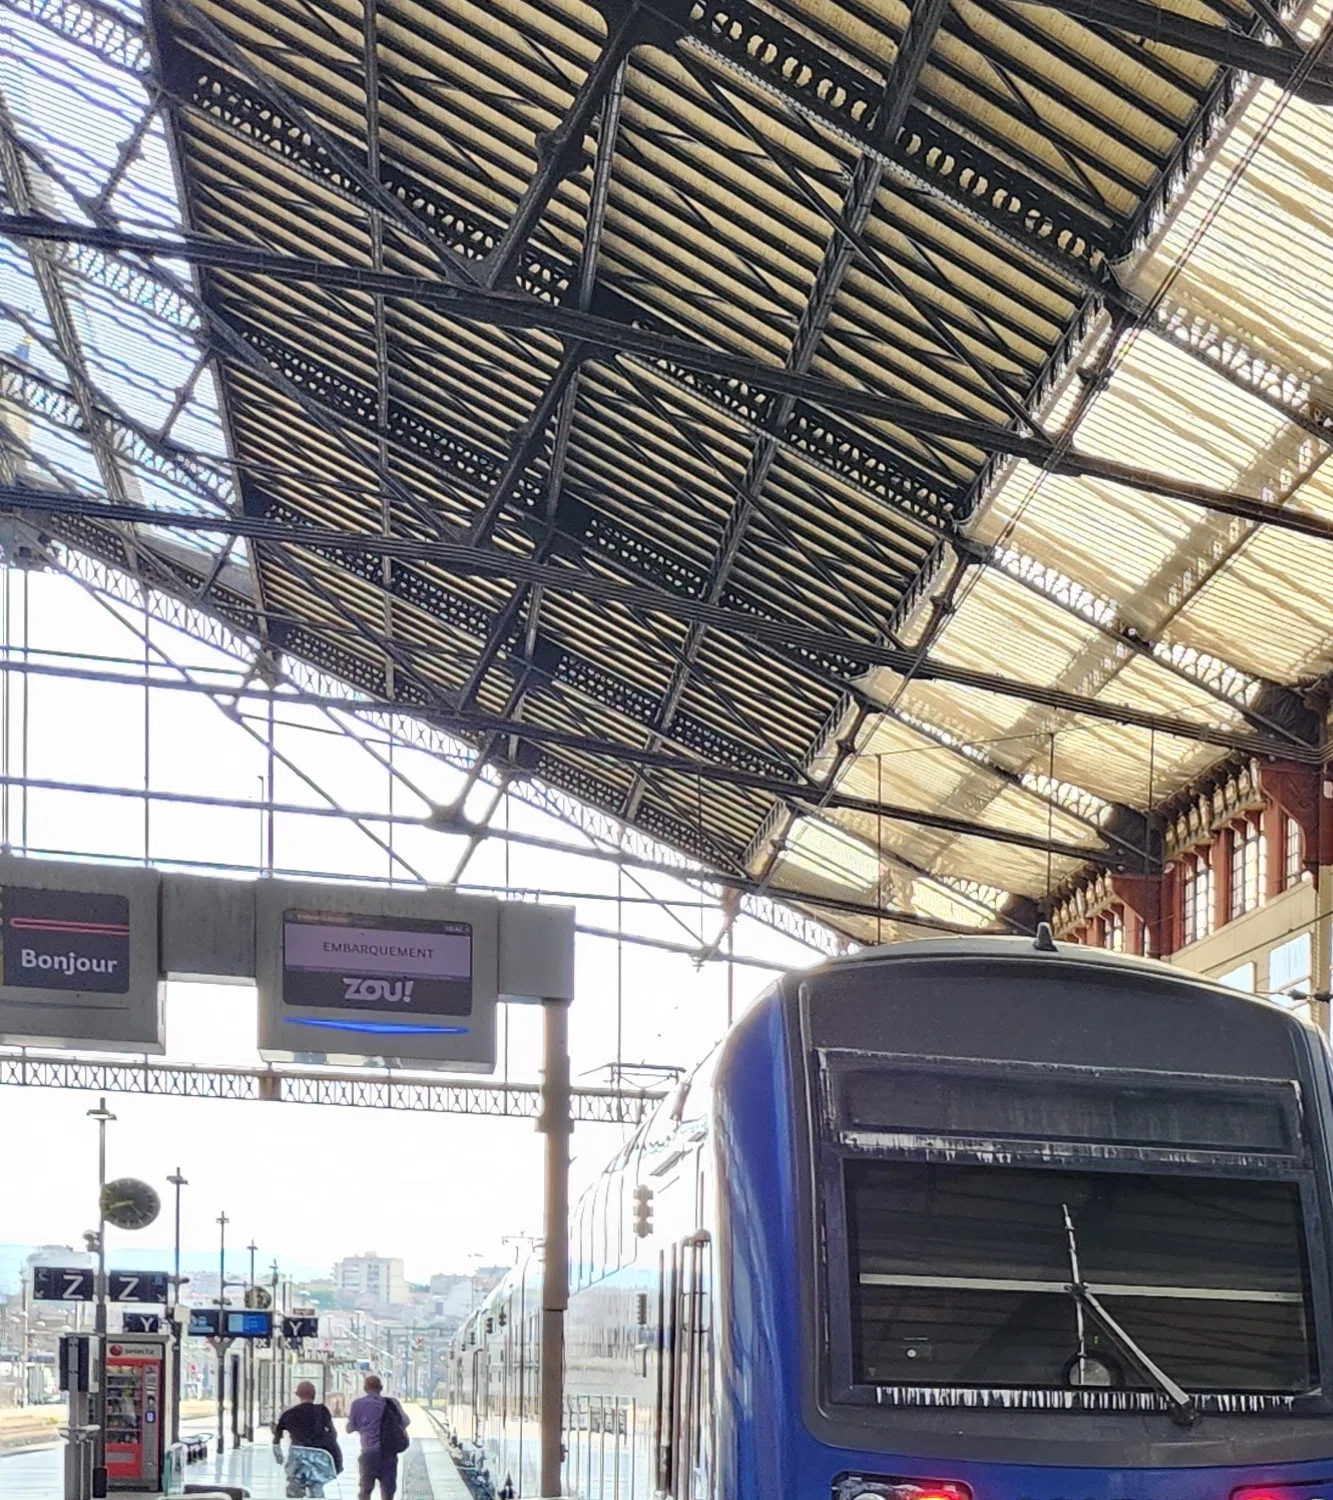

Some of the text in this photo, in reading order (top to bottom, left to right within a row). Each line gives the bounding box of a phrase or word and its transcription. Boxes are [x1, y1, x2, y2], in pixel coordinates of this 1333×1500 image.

[21, 948, 118, 975] Bonjour
[323, 941, 435, 959] EMBARQUEMENT
[342, 977, 415, 1003] ZOU!
[62, 1274, 84, 1299] Z
[118, 1276, 140, 1301] Z
[140, 1316, 154, 1333] Y
[289, 1320, 303, 1337] Y
